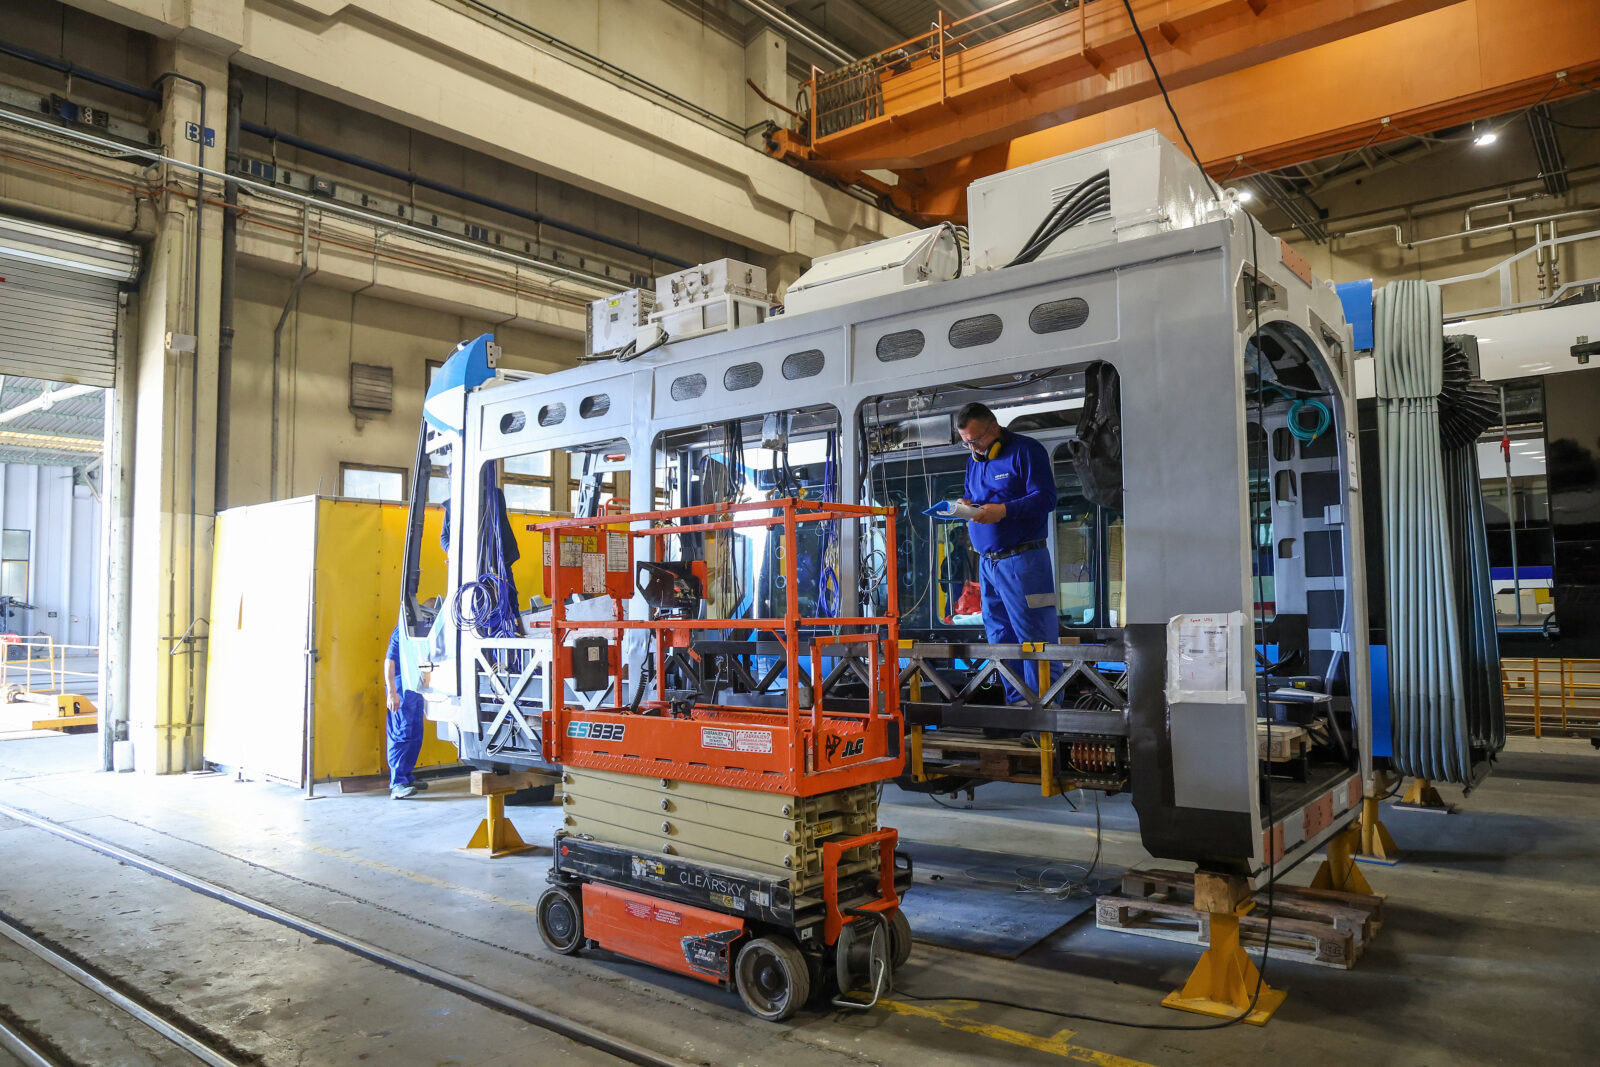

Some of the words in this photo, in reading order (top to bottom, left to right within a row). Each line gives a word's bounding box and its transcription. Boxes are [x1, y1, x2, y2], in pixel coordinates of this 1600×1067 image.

[567, 721, 625, 741] ES1932
[841, 738, 864, 758] JLG
[680, 872, 745, 896] CLEARSKY
